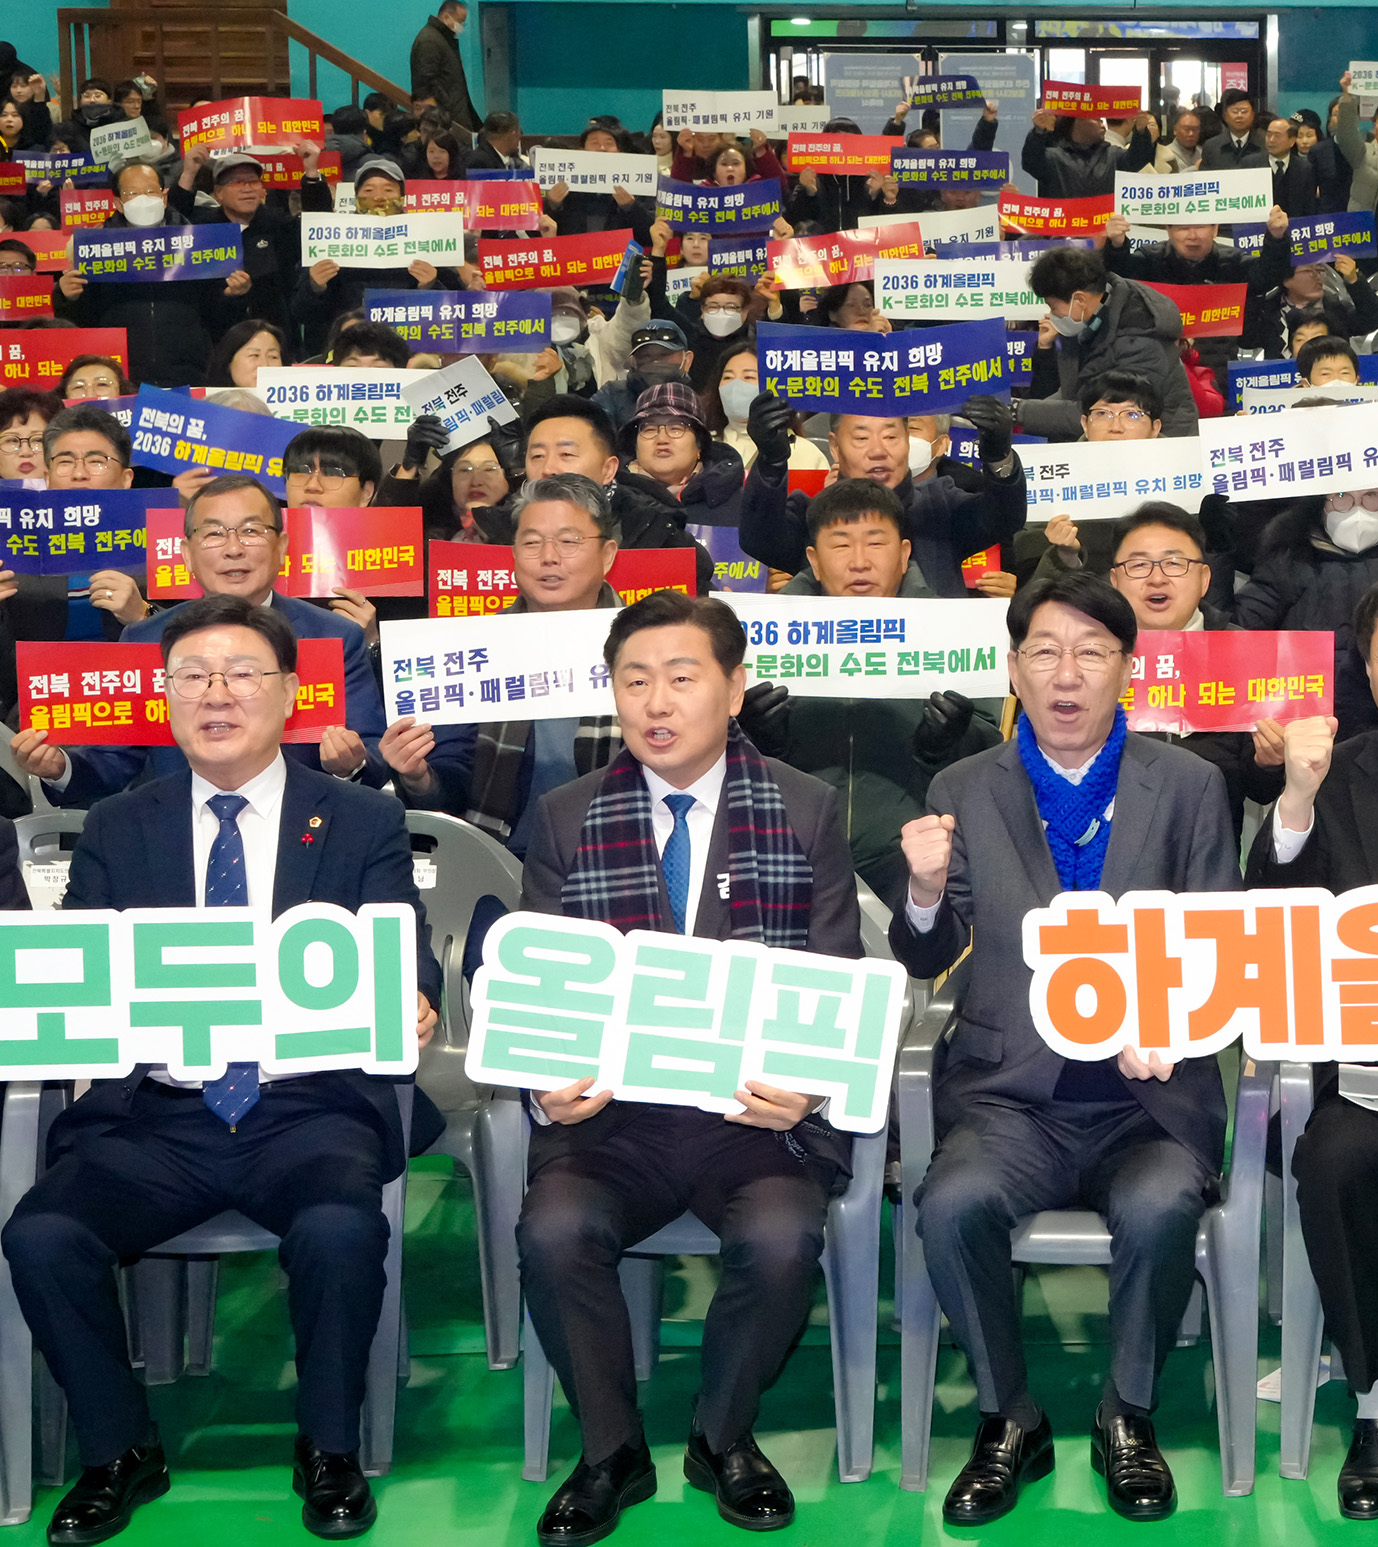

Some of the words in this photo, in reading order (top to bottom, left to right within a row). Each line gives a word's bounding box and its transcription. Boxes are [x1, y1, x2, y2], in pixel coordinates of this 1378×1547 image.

[282, 119, 320, 133] 대한민국
[959, 157, 977, 168] 희망
[931, 170, 947, 181] 수도
[973, 168, 1006, 180] 전주에서
[1121, 186, 1154, 199] 2036
[1158, 181, 1220, 198] 하계올림픽
[500, 202, 539, 217] 대한민국
[742, 200, 780, 220] 전주에서
[1121, 202, 1180, 217] K-문화의
[1184, 201, 1210, 214] 수도
[1214, 195, 1267, 211] 전북에서
[308, 227, 341, 241] 2036
[346, 225, 409, 241] 하계올림픽
[975, 225, 995, 240] 기원
[1332, 231, 1371, 249] 전주에서
[78, 240, 137, 258] 하계올림픽
[171, 235, 195, 250] 희망
[308, 241, 369, 258] K-문화의
[373, 241, 399, 258] 수도
[404, 236, 457, 255] 전북에서
[879, 243, 919, 261] 대한민국
[78, 260, 128, 276] K-문화의
[132, 256, 157, 270] 수도
[190, 246, 238, 264] 전주에서
[483, 255, 503, 269] 전북
[508, 251, 539, 266] 전주의
[540, 265, 561, 278] 하나
[567, 260, 588, 274] 되는
[882, 275, 919, 290] 2036
[924, 272, 996, 288] 하계올림픽
[369, 305, 433, 322] 하계올림픽
[439, 304, 466, 320] 유치
[472, 302, 498, 318] 희망
[882, 293, 949, 309] K-문화의
[955, 293, 984, 307] 수도
[1200, 306, 1240, 323] 대한민국
[428, 323, 454, 339] 수도
[460, 321, 487, 337] 전북
[493, 319, 545, 336] 전주에서
[765, 349, 855, 372] 하계올림픽
[862, 350, 899, 372] 유치
[908, 342, 943, 368] 희망
[4, 362, 30, 379] 하나
[38, 358, 64, 377] 되는
[765, 376, 840, 398] K-문화의
[848, 376, 884, 398] 수도
[893, 372, 929, 397] 전북
[938, 357, 1002, 390] 전주에서
[1235, 372, 1292, 388] 하계올림픽
[266, 386, 310, 403] 2036
[315, 382, 401, 401] 하계올림픽
[421, 395, 446, 416] 전북
[444, 383, 469, 405] 전주
[138, 406, 185, 436] 전북의
[186, 417, 208, 440] 꿈,
[353, 406, 388, 423] 수도
[132, 430, 171, 457] 2036
[174, 439, 264, 474] 하계올림픽
[1209, 446, 1244, 469] 전북
[1248, 438, 1286, 462] 전주
[1039, 464, 1071, 480] 전주
[1211, 452, 1353, 495] 올림픽·패럴림픽
[1135, 478, 1167, 495] 유치
[1172, 473, 1203, 490] 희망
[19, 508, 54, 529] 유치
[63, 504, 101, 527] 희망
[6, 535, 39, 555] 수도
[47, 531, 85, 554] 전북
[347, 544, 415, 571] 대한민국
[436, 569, 469, 590] 전북
[787, 618, 906, 645] 하계올림픽
[392, 655, 436, 683] 전북
[442, 647, 489, 677] 전주
[839, 652, 888, 677] 수도
[896, 646, 996, 676] 전북에서
[1155, 654, 1181, 680] 꿈,
[28, 672, 70, 699] 전북
[80, 668, 142, 696] 전주의
[394, 668, 574, 716] 올림픽·패럴림픽
[1147, 683, 1187, 709] 하나
[1198, 681, 1236, 706] 되는
[1247, 674, 1325, 703] 대한민국
[29, 700, 133, 730] 올림픽으로
[0, 917, 403, 1066] 모두의
[481, 926, 892, 1119] 올림픽
